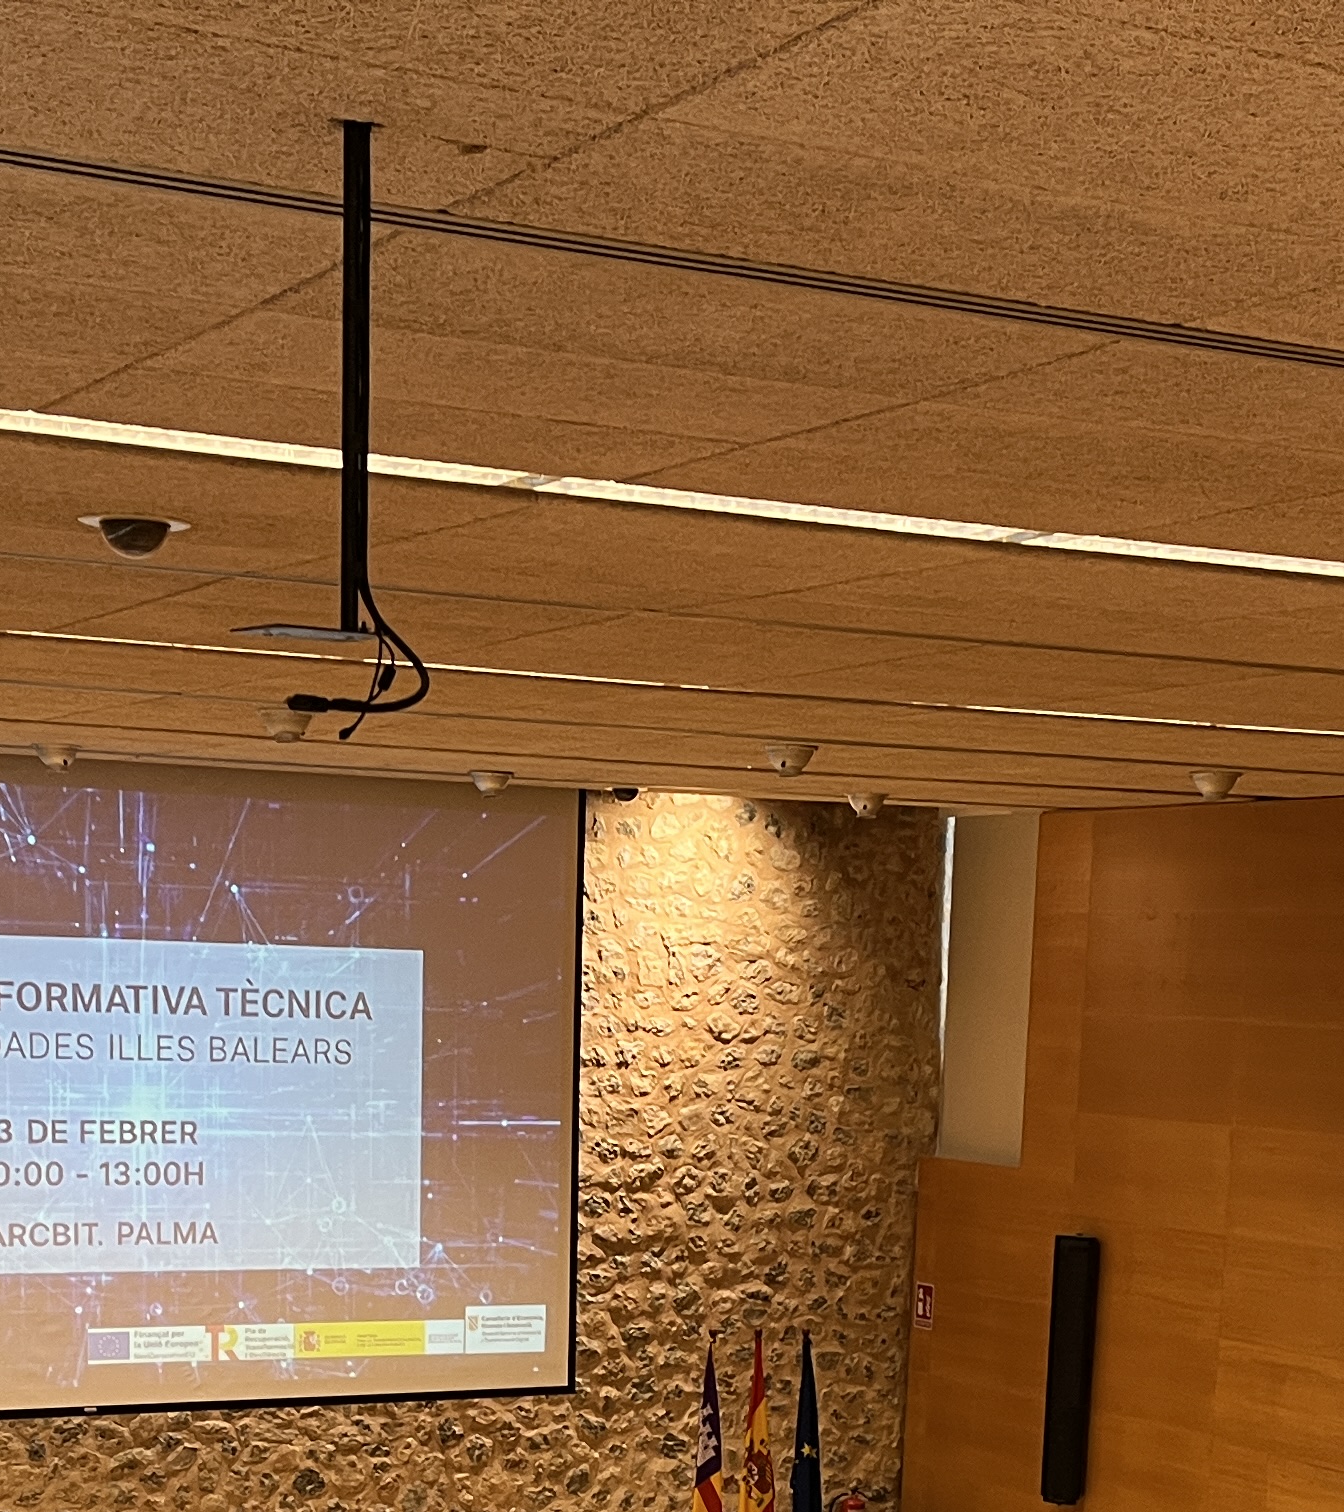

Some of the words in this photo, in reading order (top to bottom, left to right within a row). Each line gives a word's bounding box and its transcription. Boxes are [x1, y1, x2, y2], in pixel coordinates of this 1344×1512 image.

[216, 978, 373, 1020] TÈCNICA
[109, 1033, 195, 1062] ILLES
[209, 1036, 352, 1065] BALEARS
[27, 1119, 68, 1144] DE
[80, 1119, 198, 1145] FEBRER
[99, 1161, 204, 1186] 13:00H
[117, 1221, 219, 1246] PALMA
